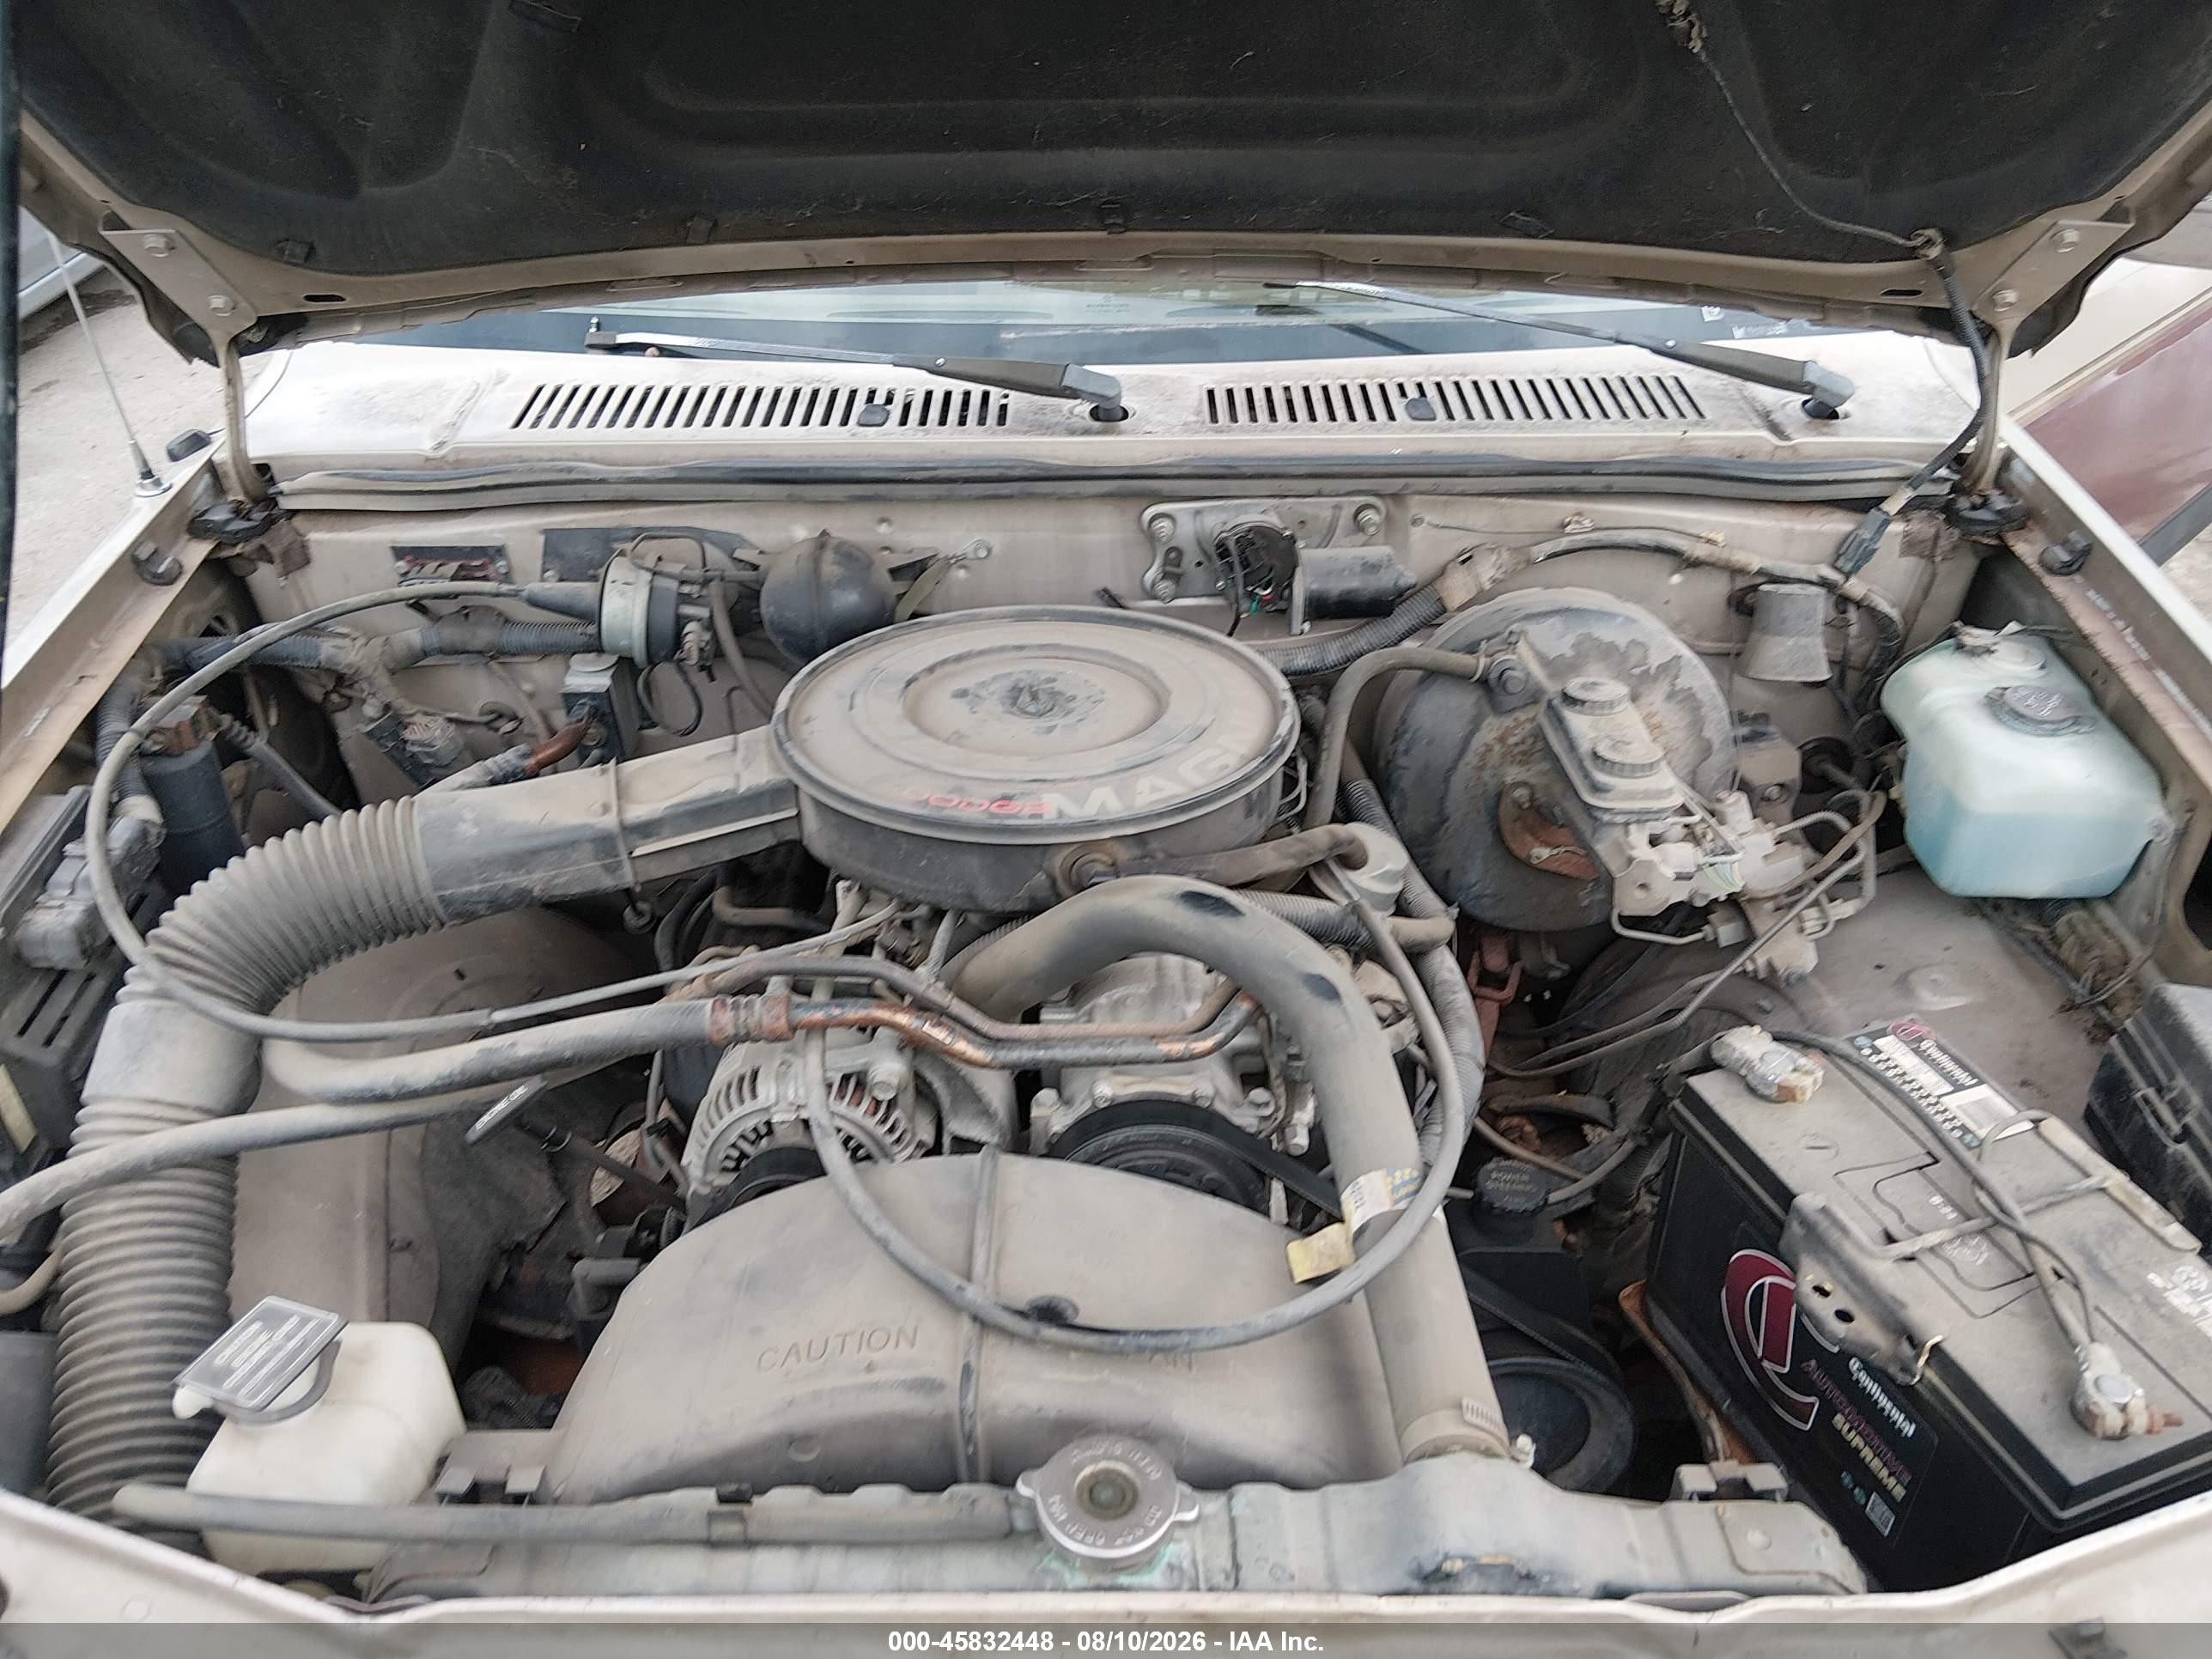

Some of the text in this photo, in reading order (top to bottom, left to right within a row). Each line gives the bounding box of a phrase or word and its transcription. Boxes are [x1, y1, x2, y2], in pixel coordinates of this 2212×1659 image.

[756, 1324, 920, 1371] CAUTION
[1848, 1357, 1917, 1438] Continental
[1831, 1412, 1907, 1503] SUPREME
